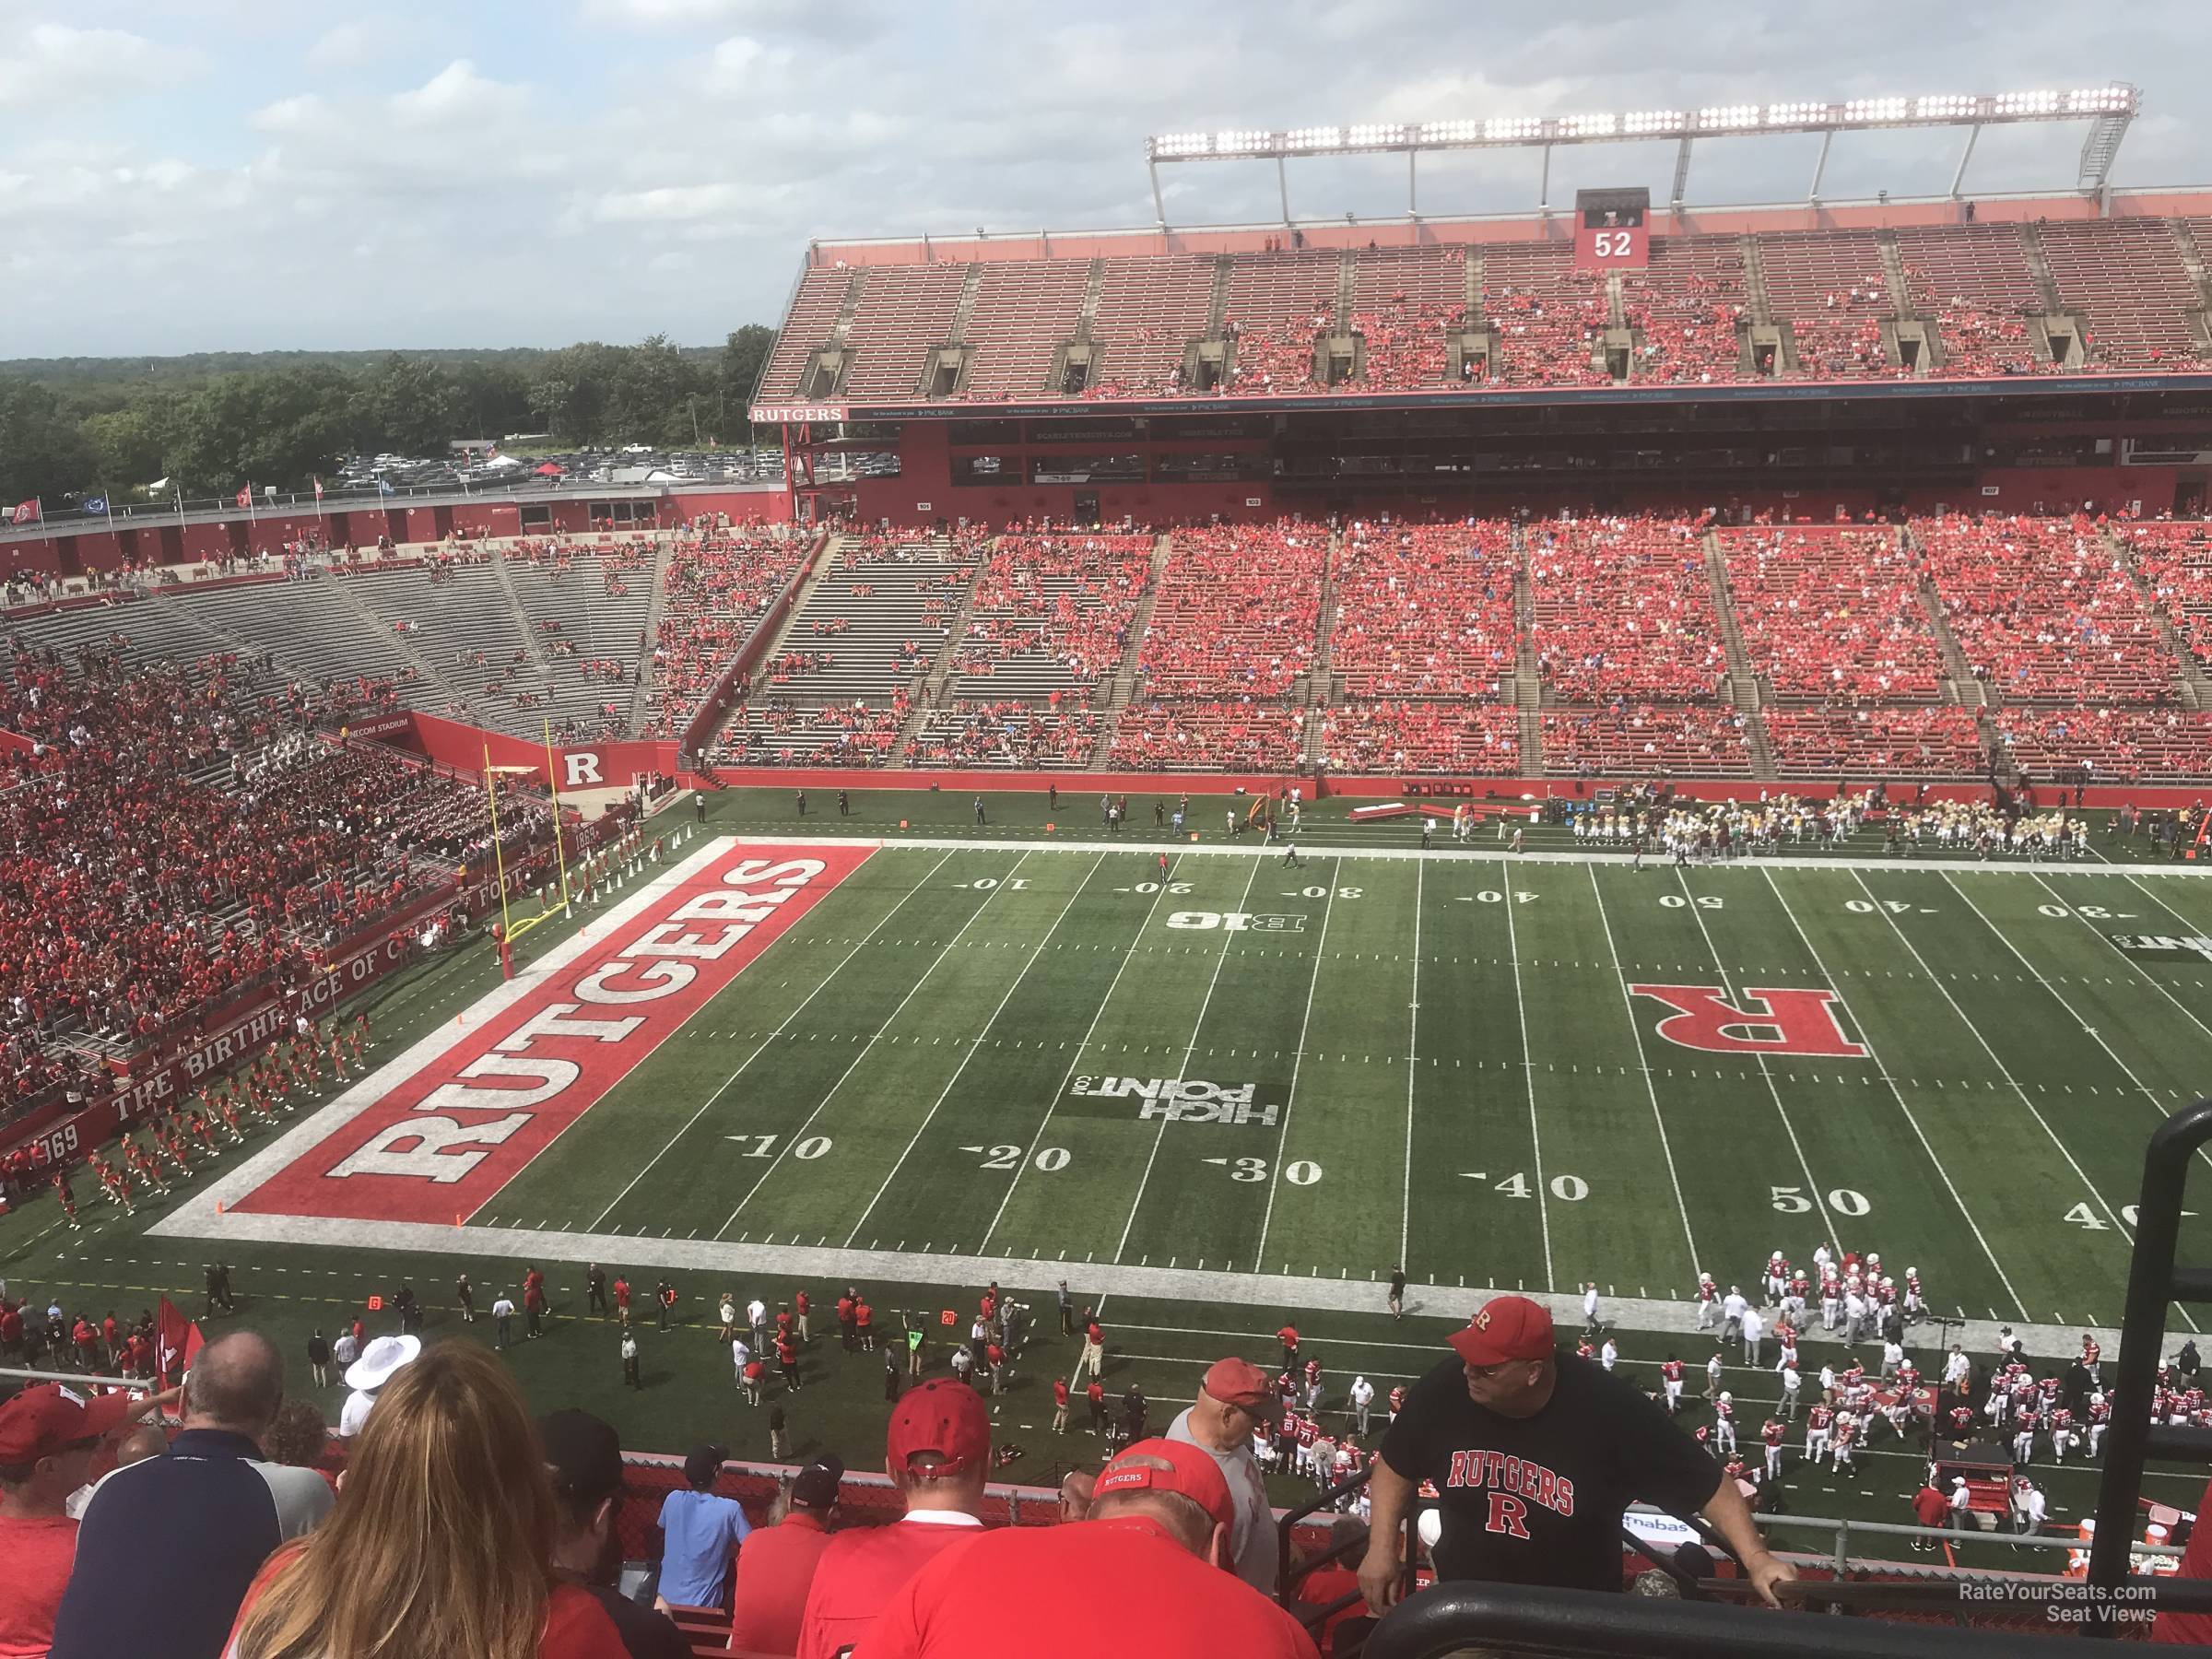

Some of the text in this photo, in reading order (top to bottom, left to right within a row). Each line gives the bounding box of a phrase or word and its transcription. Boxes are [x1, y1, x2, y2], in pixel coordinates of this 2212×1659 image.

[1594, 232, 1631, 257] 52
[753, 408, 842, 421] RUTGERS
[378, 718, 408, 732] STADIUM
[563, 752, 604, 785] R
[575, 827, 596, 852] 1869
[973, 877, 1033, 890] 10
[1135, 882, 1196, 894] 20
[1301, 886, 1364, 900] 30
[1477, 890, 1540, 903] 40
[1659, 895, 1724, 910] 50
[1845, 900, 1912, 913] 40
[2037, 904, 2112, 919] 30
[324, 858, 827, 1184] RUTGERS
[1626, 982, 1871, 1058] R
[111, 1069, 174, 1122] THE
[351, 949, 378, 981] OF
[1138, 1100, 1278, 1126] HIGH
[742, 1135, 833, 1159] 10
[980, 1145, 1071, 1171] 20
[1231, 1158, 1323, 1185] 30
[1494, 1172, 1589, 1201] 40
[1770, 1186, 1872, 1217] 50
[943, 1312, 954, 1324] 20
[1477, 1310, 1491, 1331] R
[1283, 1422, 1293, 1431] 61
[1818, 1417, 1828, 1427] 17
[1300, 1430, 1312, 1442] 77
[1105, 1473, 1143, 1487] RUTGERS
[1446, 1450, 1574, 1517] RUTGERS
[1485, 1491, 1530, 1539] R
[1623, 1514, 1688, 1532] rnabas
